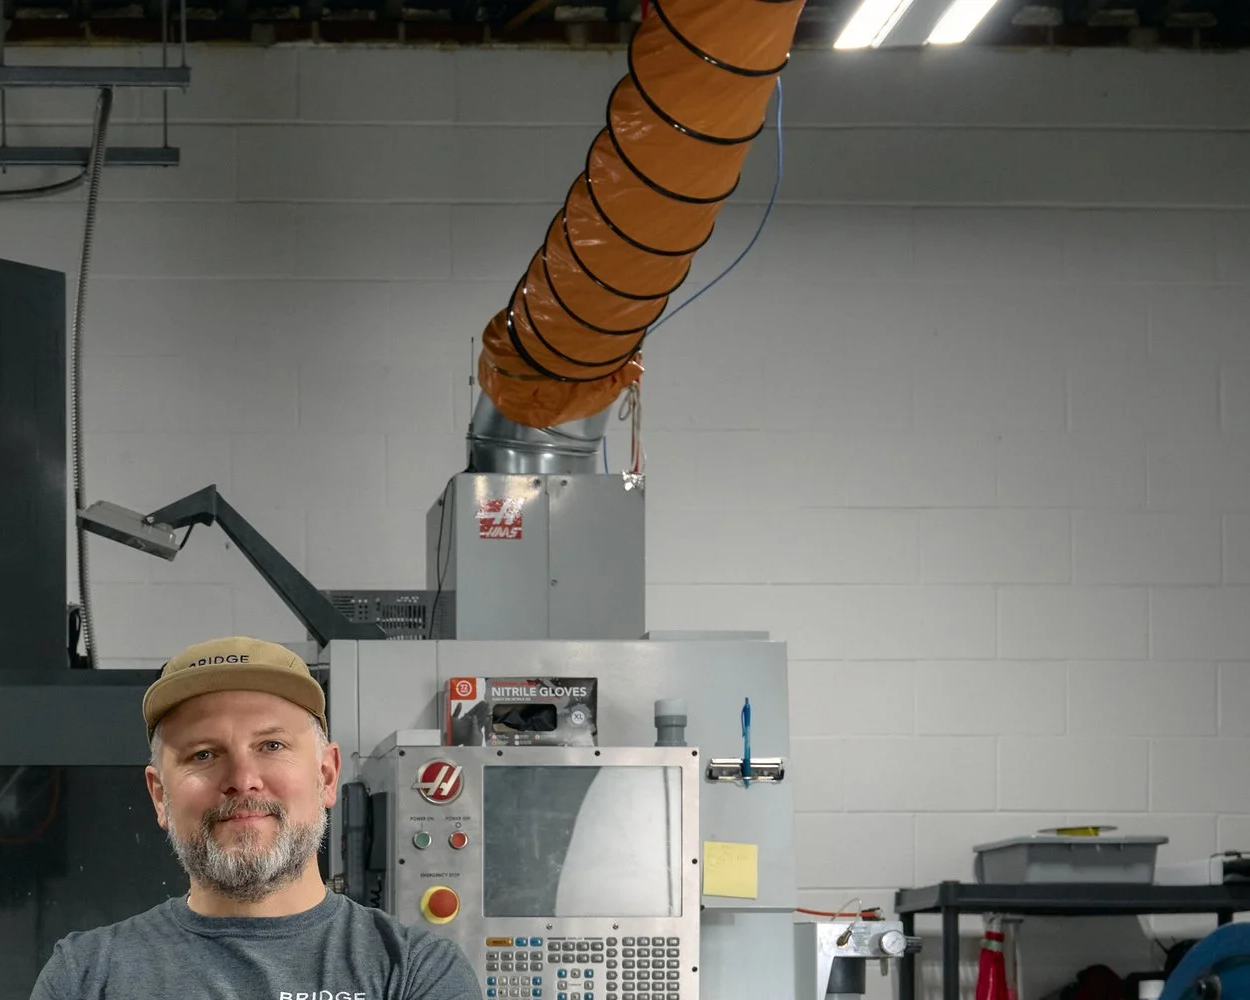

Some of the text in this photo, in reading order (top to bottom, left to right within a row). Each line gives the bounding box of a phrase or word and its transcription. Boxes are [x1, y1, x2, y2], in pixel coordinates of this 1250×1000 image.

[491, 686, 587, 697] NITRILE GLOVES
[574, 713, 584, 721] XL
